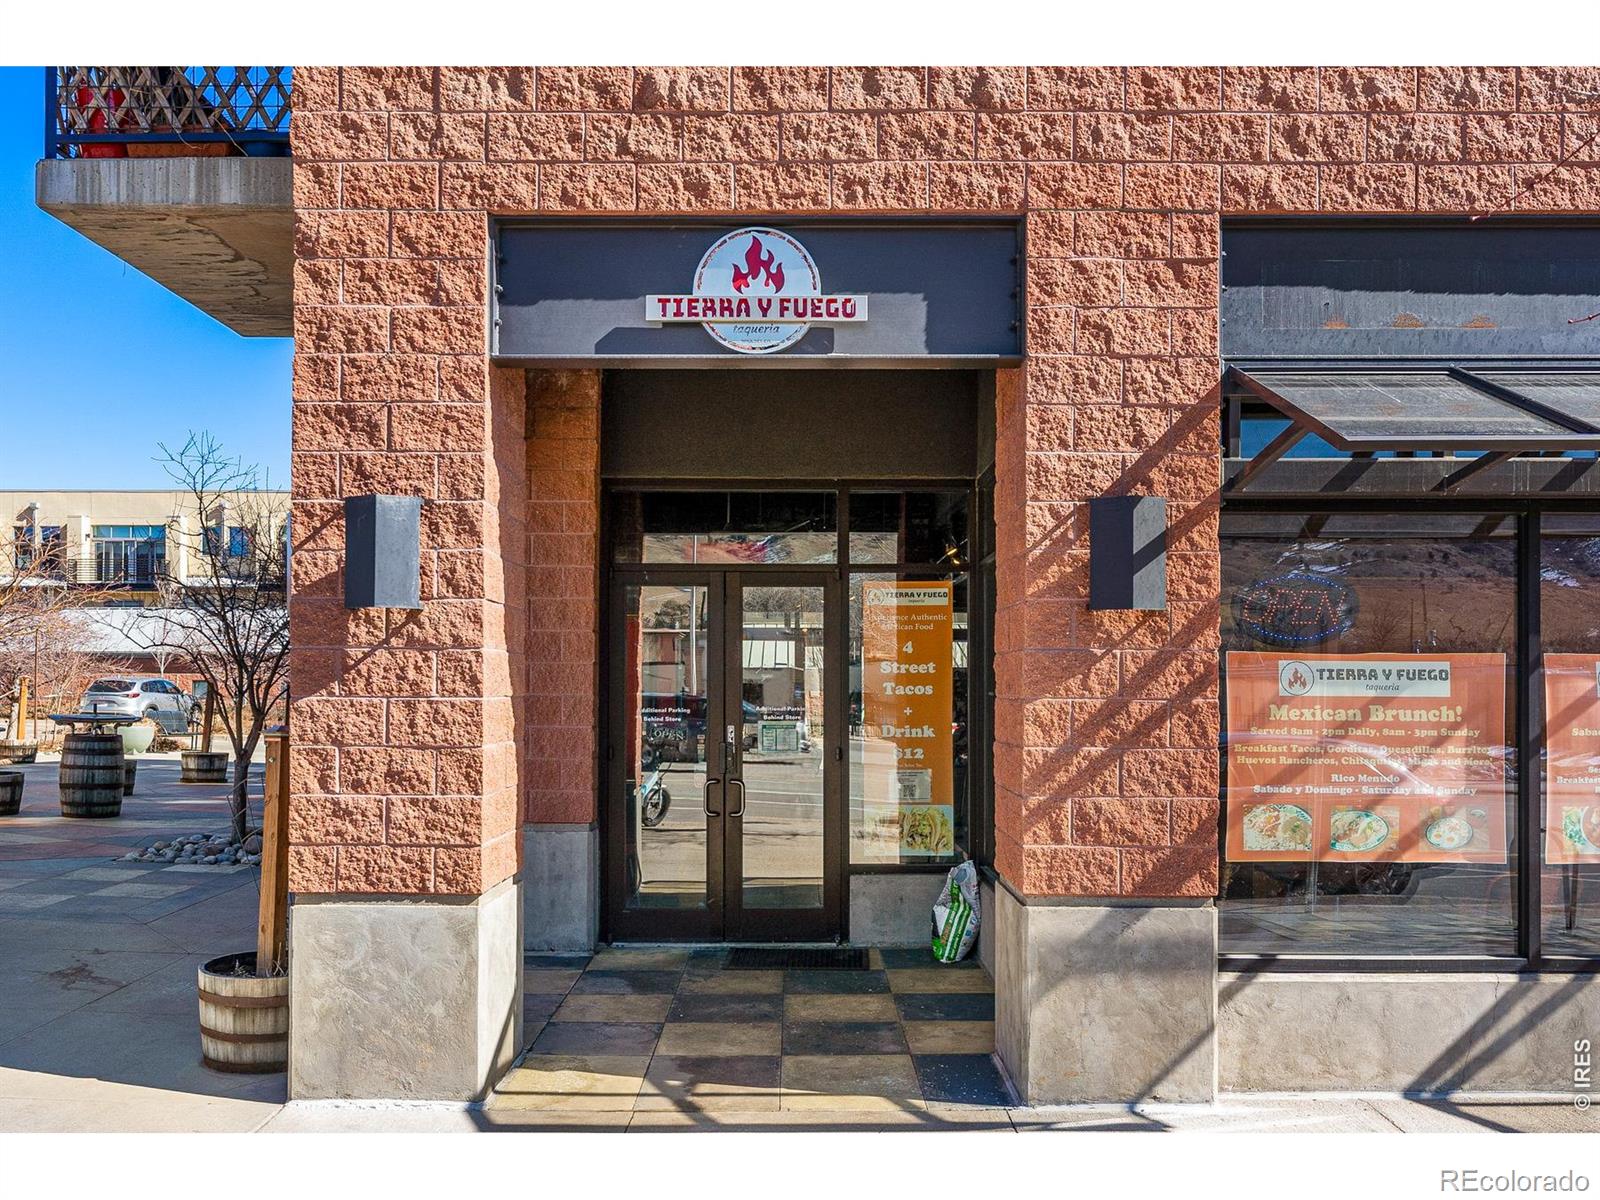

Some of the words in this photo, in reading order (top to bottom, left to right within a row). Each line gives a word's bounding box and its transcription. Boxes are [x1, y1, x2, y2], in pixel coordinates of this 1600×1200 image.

[657, 298, 751, 318] TIERRA
[758, 298, 772, 318] Y
[779, 298, 857, 318] FUEGO
[733, 323, 780, 336] taqueria
[1245, 589, 1346, 625] OPEN
[911, 613, 948, 621] Authentic
[903, 641, 914, 654] 4
[880, 661, 937, 674] Street
[1316, 668, 1378, 681] TIERRA
[1382, 668, 1392, 681] Y
[1396, 668, 1449, 682] FUEGO
[882, 682, 934, 695] Tacos
[1365, 682, 1400, 692] taqueria
[1269, 704, 1362, 721] Mexican
[1369, 705, 1463, 722] Brunch!
[881, 724, 936, 738] Drink
[1250, 726, 1288, 736] Served
[1291, 727, 1313, 736] 8am
[1322, 728, 1345, 738] 2pm
[1348, 727, 1380, 738] Daily,
[1382, 728, 1406, 737] 8am
[1414, 729, 1438, 738] 3pm
[1440, 728, 1480, 738] Sunday
[1233, 743, 1288, 753] Breakfast
[1290, 744, 1325, 755] Tacos,
[1236, 755, 1277, 765] Huevos
[1279, 756, 1339, 766] Rancheros,
[1331, 773, 1356, 783] Rico
[1358, 774, 1401, 783] Menudo
[1253, 784, 1293, 794] Sabado
[1295, 786, 1302, 795] y
[1304, 785, 1353, 796] Domingo
[1361, 785, 1412, 796] Saturday
[1437, 786, 1478, 797] Sunday
